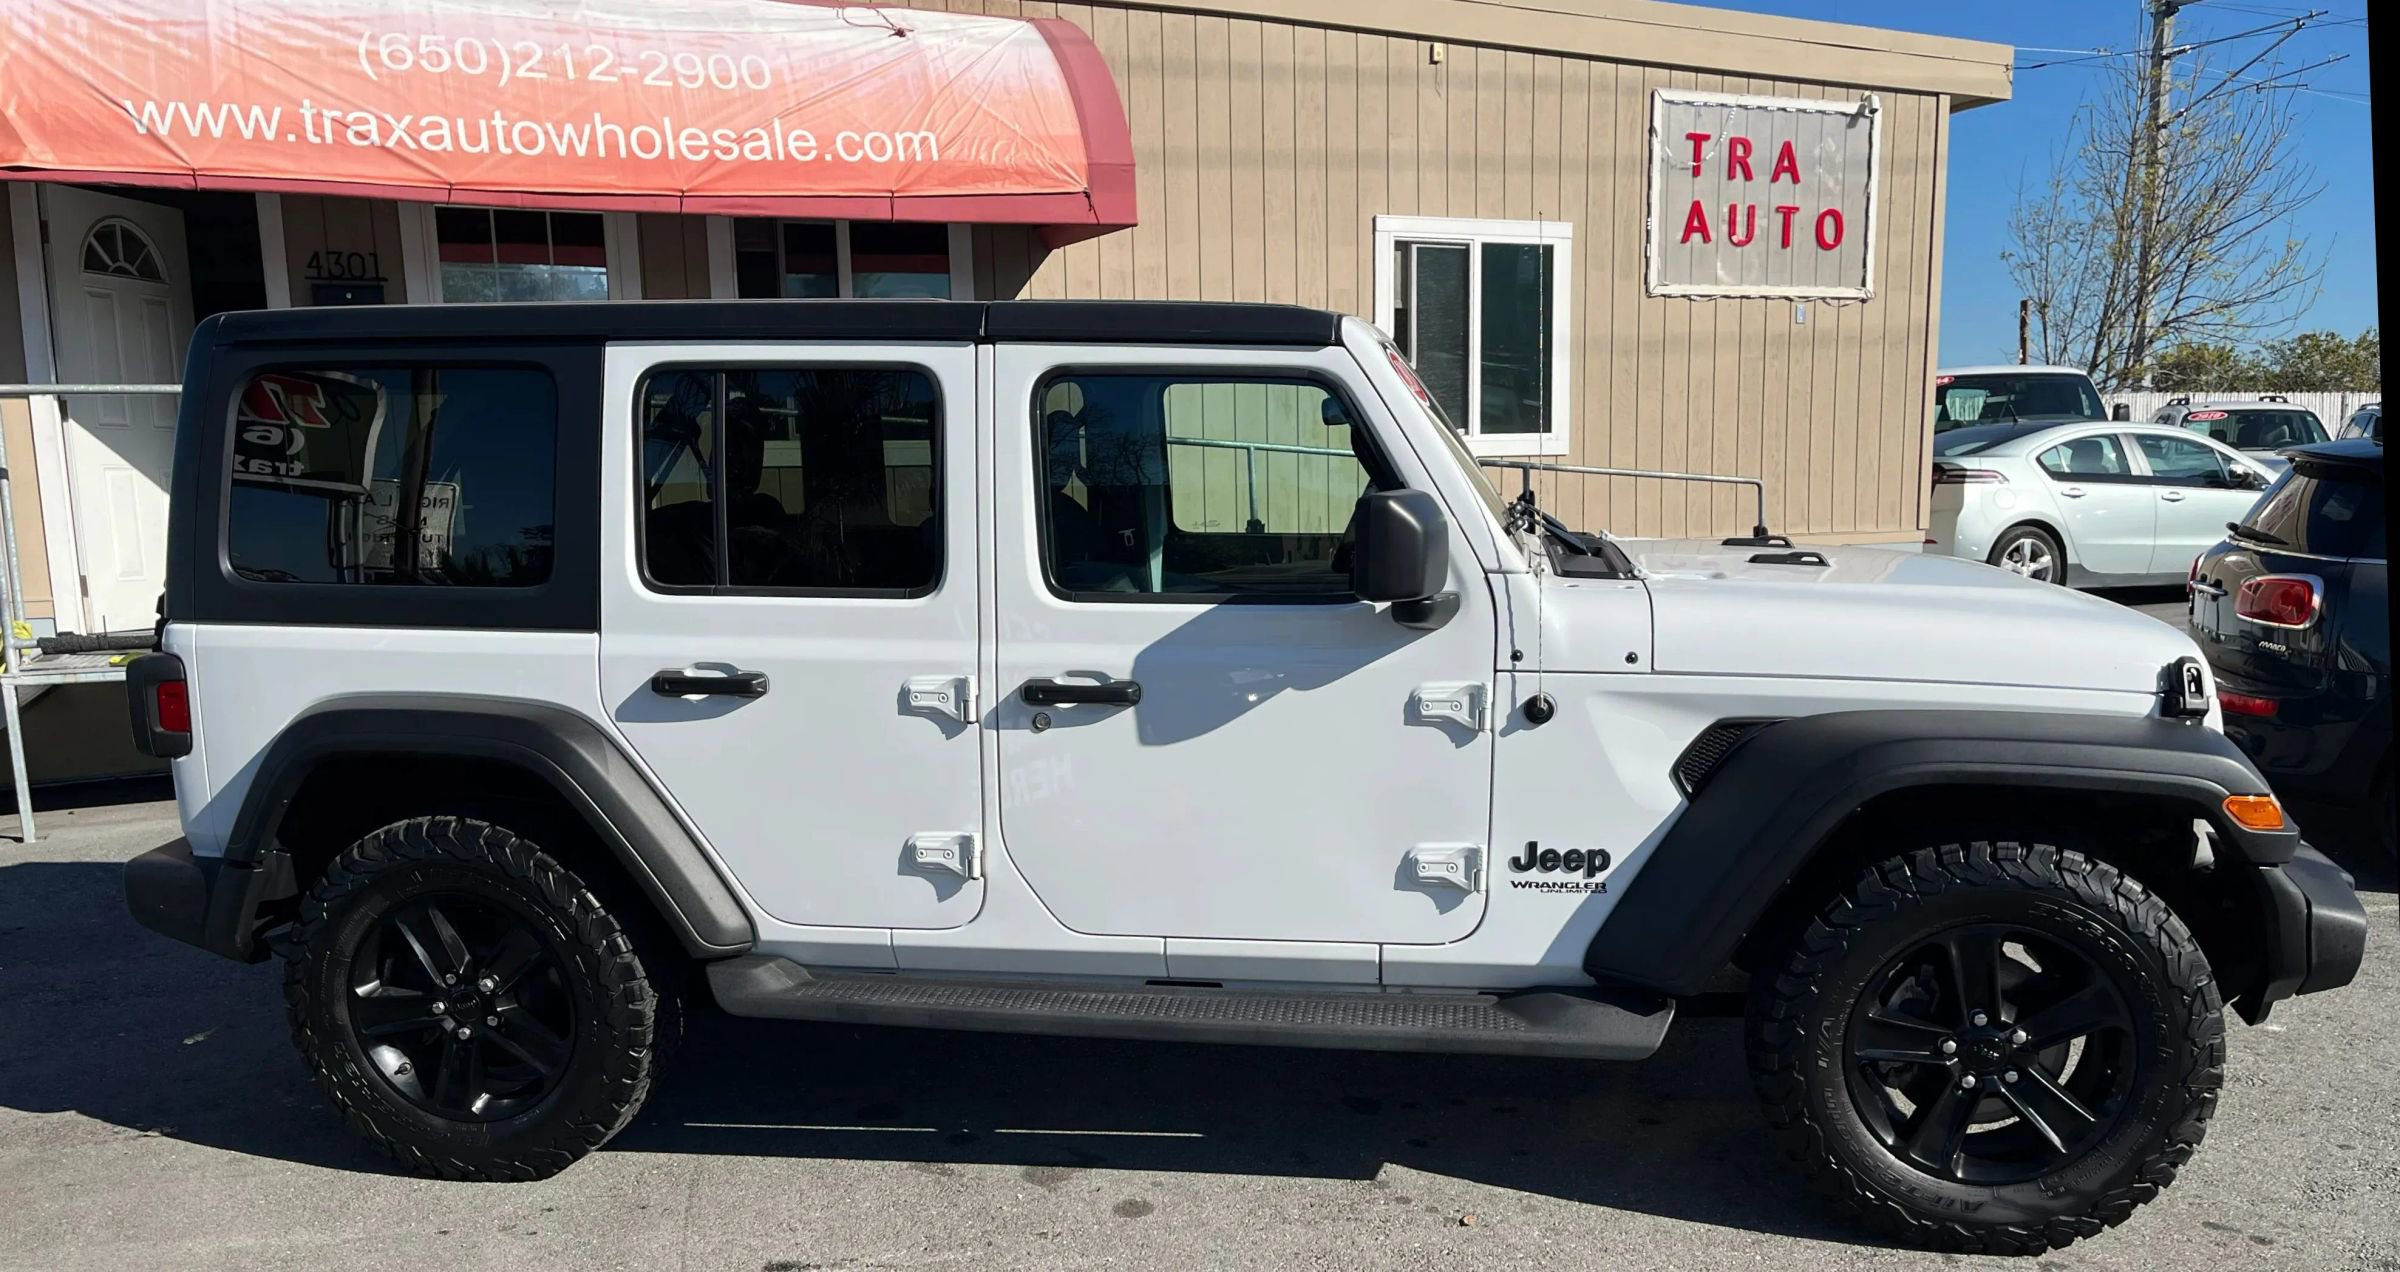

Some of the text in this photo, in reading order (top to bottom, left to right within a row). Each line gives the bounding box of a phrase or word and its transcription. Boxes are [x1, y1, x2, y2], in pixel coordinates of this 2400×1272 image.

[357, 30, 772, 91] (650)212-2900
[123, 97, 940, 164] www.traxautowholesale.com
[1680, 200, 1844, 251] AUTO
[305, 250, 382, 279] 4301
[1508, 840, 1611, 879] Jeep
[1510, 880, 1607, 890] WRANGLER
